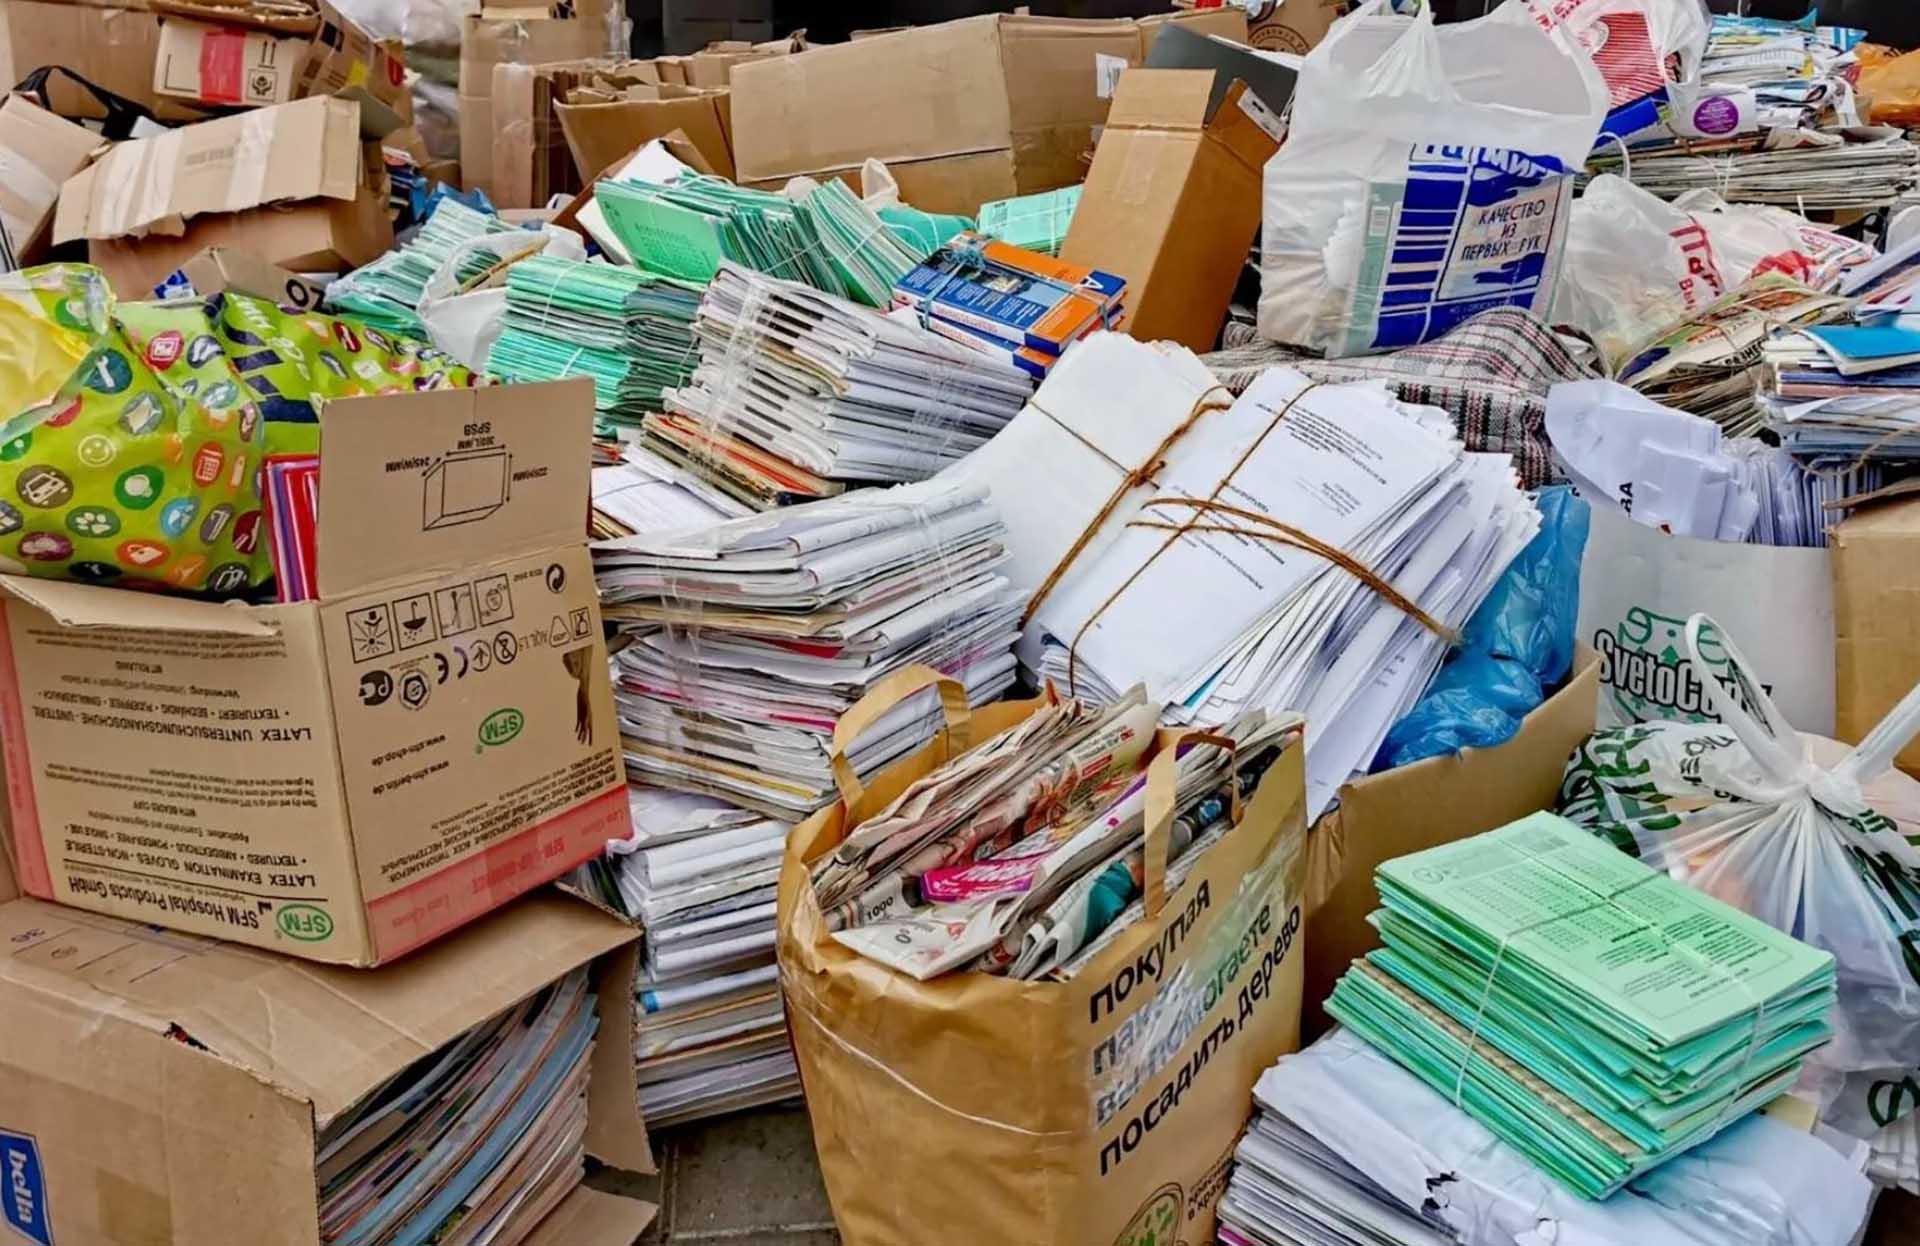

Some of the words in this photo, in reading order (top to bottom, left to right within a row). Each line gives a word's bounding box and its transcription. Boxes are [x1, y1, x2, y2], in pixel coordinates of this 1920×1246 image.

[1478, 199, 1546, 226] КАЧЕСТВО
[1500, 223, 1517, 239] ИЗ
[1461, 242, 1511, 261] ПЕРВЫХ
[1517, 235, 1542, 254] РУК
[260, 727, 312, 742] LATEX
[484, 714, 520, 741] SFM
[135, 851, 180, 871] GLOVES
[183, 860, 263, 885] EXAMINATION
[68, 875, 108, 898] GmbH
[268, 873, 316, 888] LATEX
[109, 883, 168, 911] Products
[168, 894, 225, 922] Hospital
[226, 906, 260, 929] SFM
[282, 912, 328, 934] SFM
[1089, 880, 1211, 1025] покупая
[1100, 1018, 1235, 1177] посадить
[1239, 905, 1301, 1031] дерево
